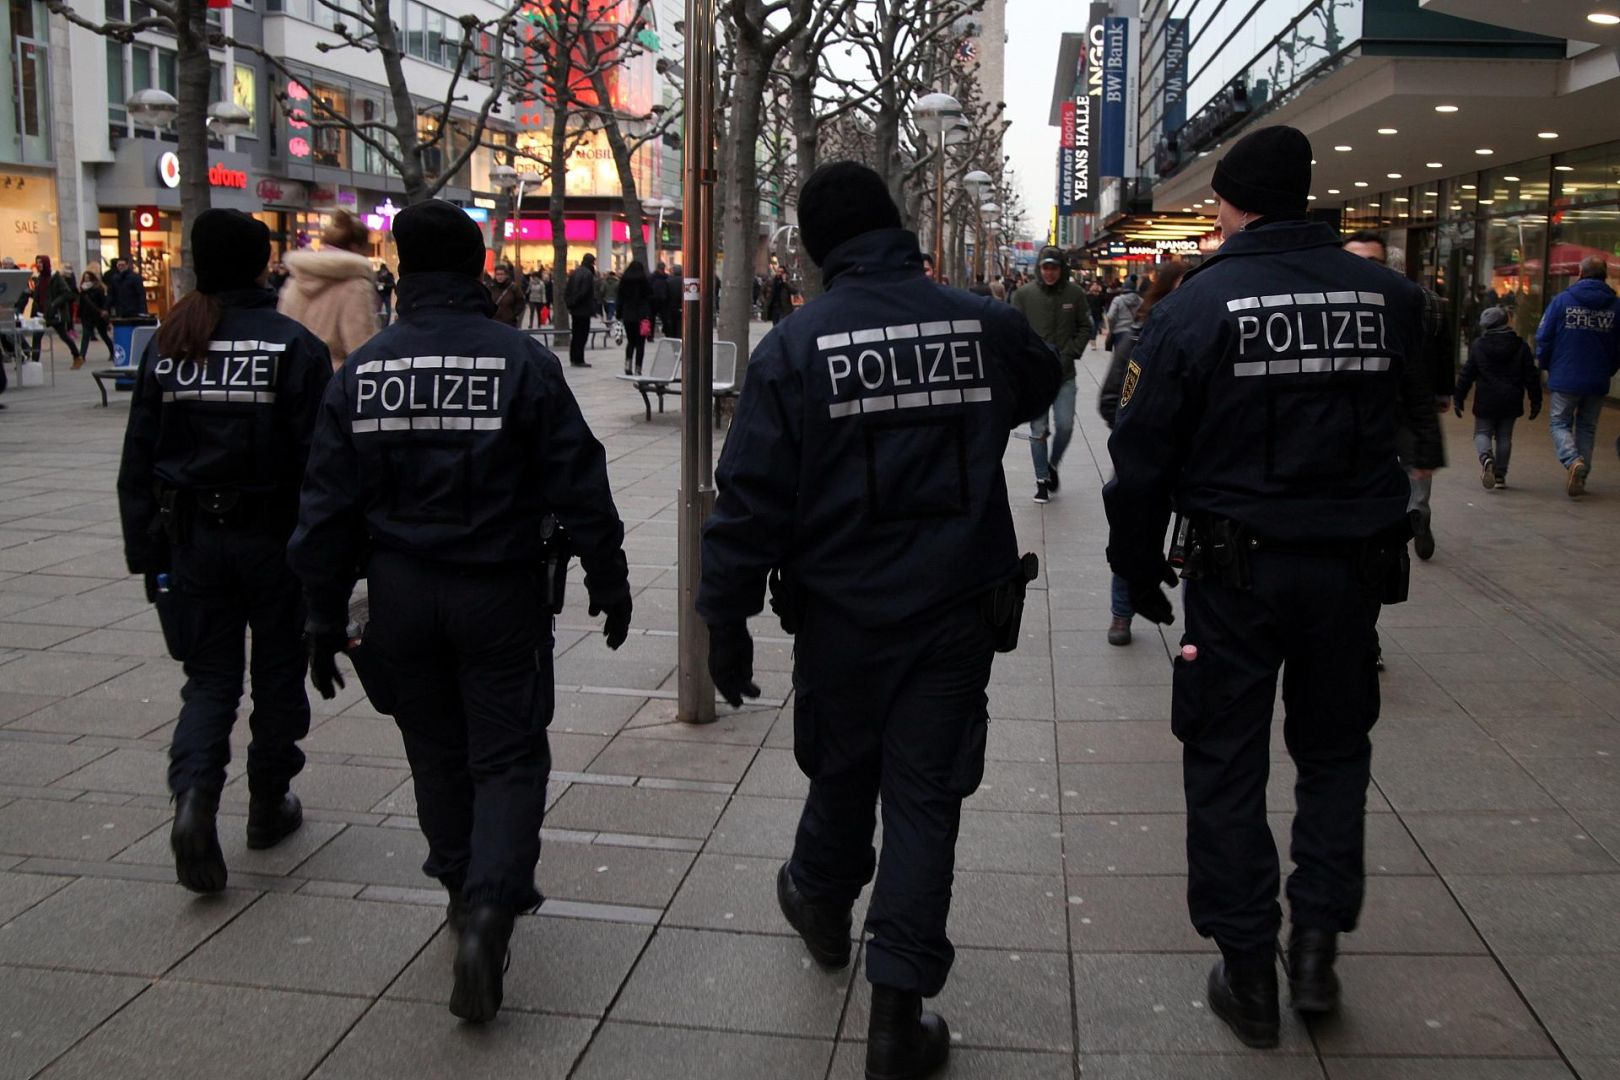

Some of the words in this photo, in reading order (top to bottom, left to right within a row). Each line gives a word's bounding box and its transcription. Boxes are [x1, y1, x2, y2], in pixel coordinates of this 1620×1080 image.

[1088, 24, 1105, 96] NGO
[1106, 23, 1124, 68] Bank
[1106, 74, 1122, 103] BW
[1063, 110, 1075, 147] sports
[1076, 95, 1090, 147] HALLE
[208, 162, 248, 189] afone
[1063, 148, 1073, 206] KARSTADT
[1074, 149, 1089, 201] YEANS
[15, 219, 39, 235] SALE
[1156, 240, 1198, 250] MANGO
[1237, 311, 1387, 355] POLIZEI
[1565, 313, 1615, 329] CREW
[154, 355, 280, 386] POLIZEI
[826, 340, 985, 396] POLIZEI
[356, 374, 500, 414] POLIZEI
